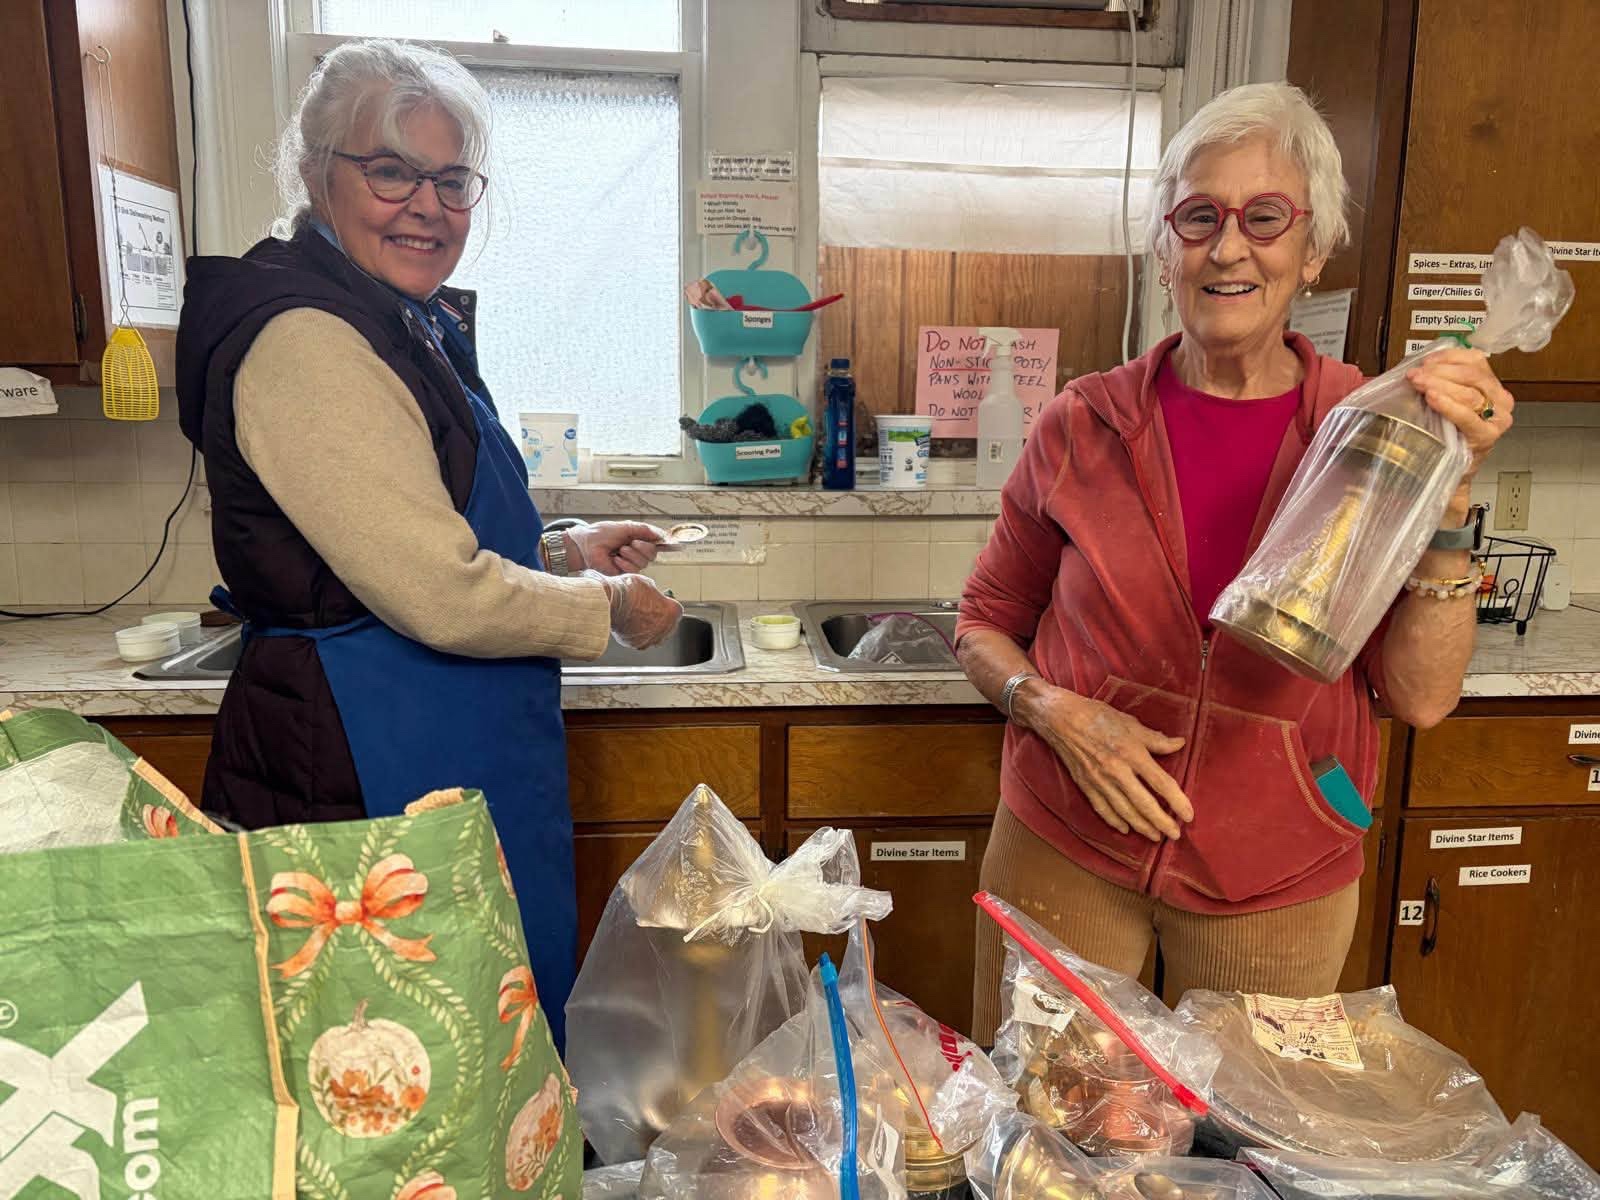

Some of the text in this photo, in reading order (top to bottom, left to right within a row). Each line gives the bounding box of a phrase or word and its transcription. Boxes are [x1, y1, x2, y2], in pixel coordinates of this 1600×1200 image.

[1574, 247, 1592, 256] Star
[1413, 259, 1440, 268] Spices
[1449, 260, 1477, 269] Extras,
[744, 315, 771, 323] Sponges
[1415, 314, 1484, 326] Empty Spice Jars
[959, 336, 987, 351] NOT
[1010, 340, 1036, 350] ASH
[928, 372, 960, 386] PANS
[1013, 374, 1047, 388] TEEL
[0, 386, 38, 397] ware
[953, 389, 985, 400] WOOL
[952, 406, 978, 417] NOT
[765, 447, 780, 455] Pads
[1435, 832, 1515, 844] Divine Star Items
[876, 848, 959, 857] Divine Star Items
[1469, 867, 1528, 878] Rice Cookers
[1401, 906, 1423, 921] 12
[122, 1097, 161, 1200] om
